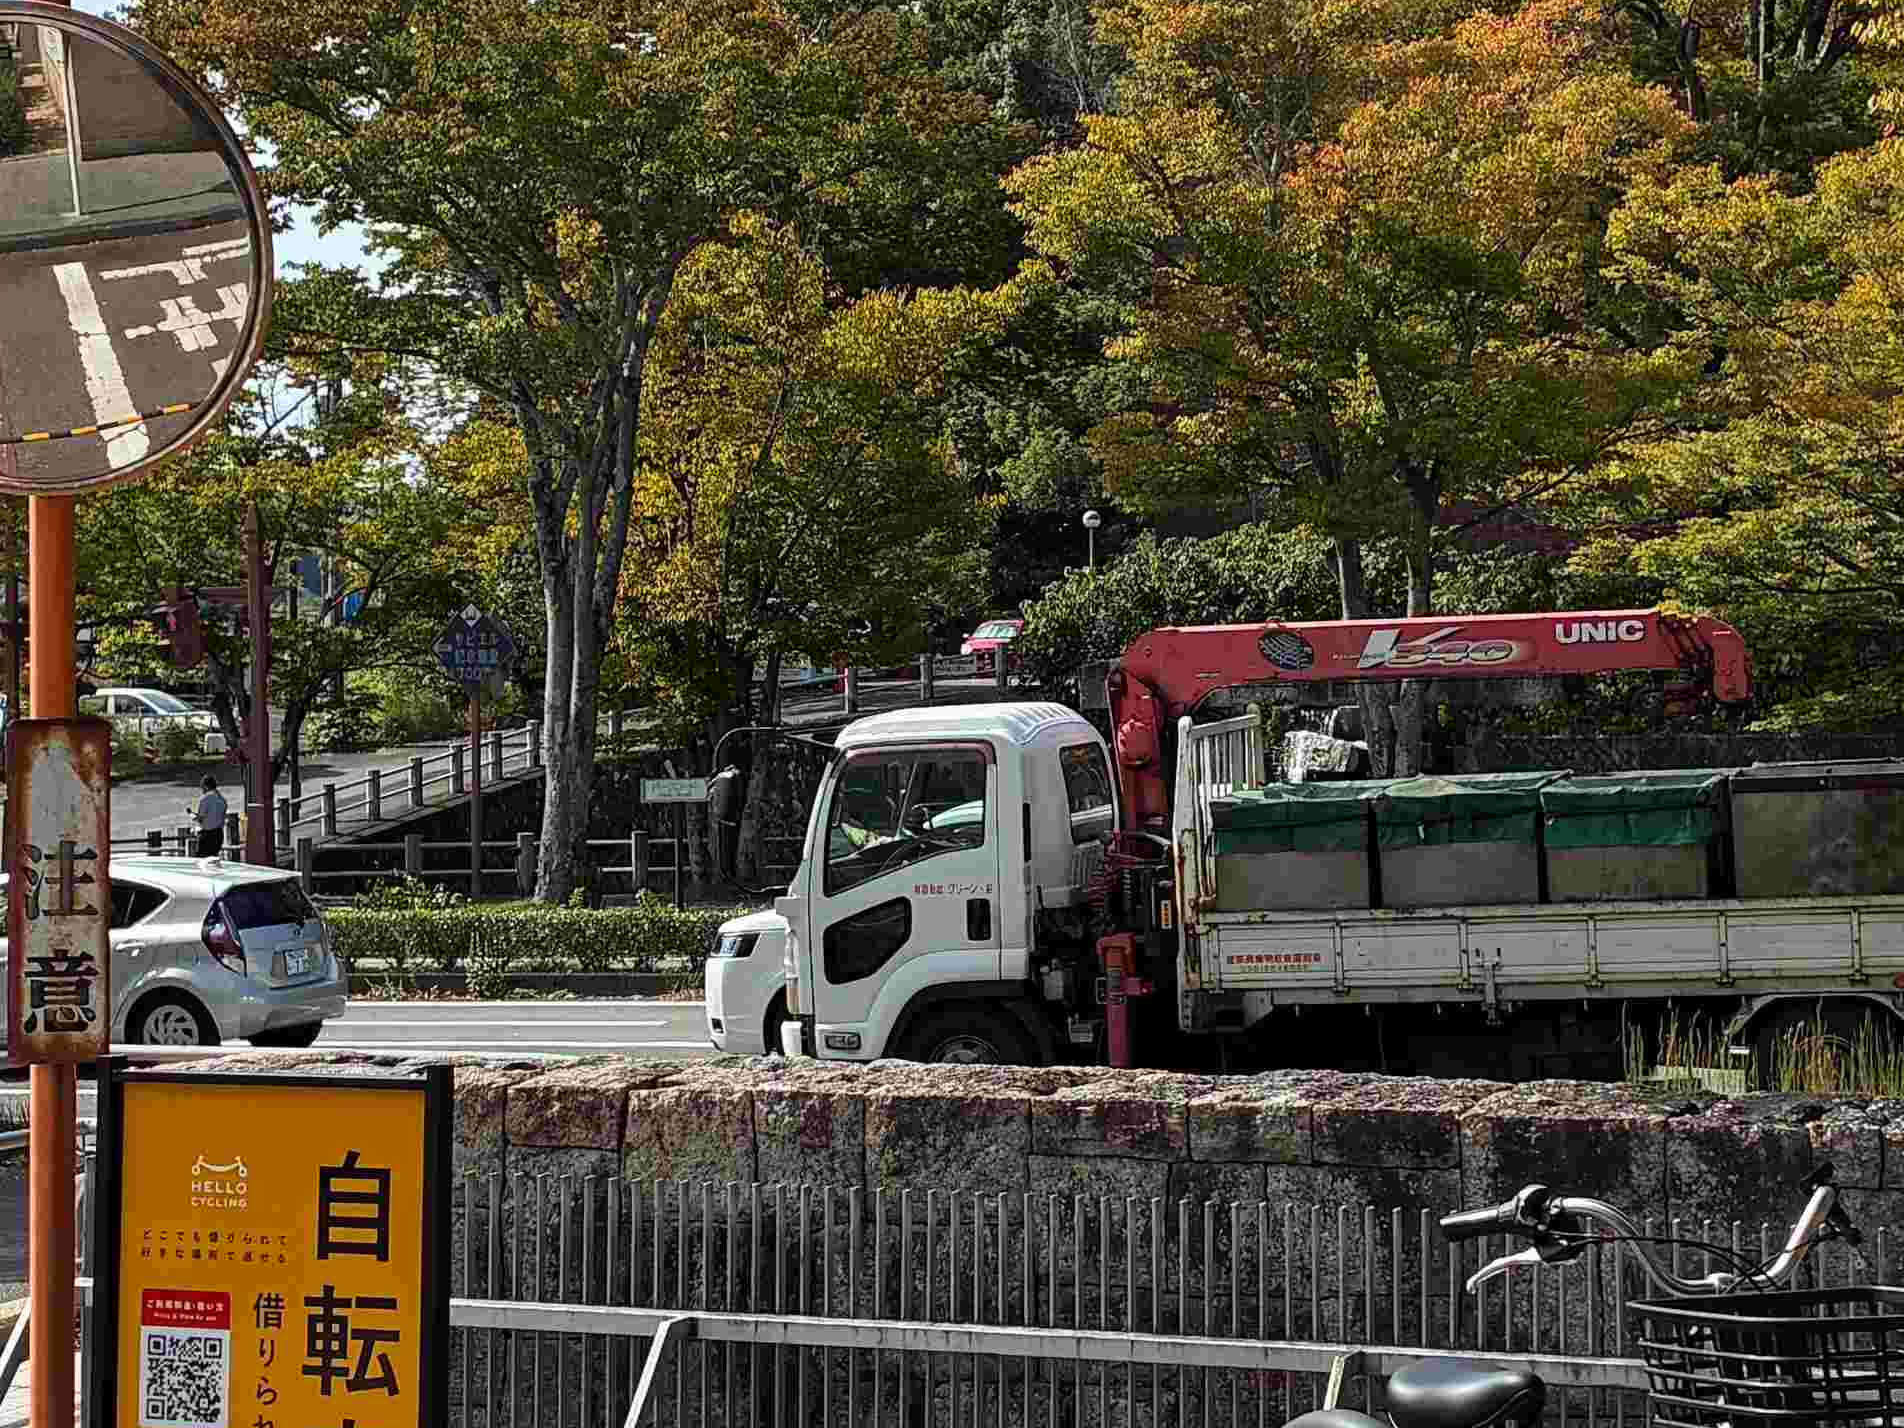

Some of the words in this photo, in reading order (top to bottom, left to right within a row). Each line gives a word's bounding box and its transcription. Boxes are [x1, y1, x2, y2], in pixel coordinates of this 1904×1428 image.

[1554, 619, 1646, 644] UNIC
[22, 838, 100, 1033] 注意
[192, 1180, 248, 1195] HELLO
[192, 1196, 248, 1210] CYCLING
